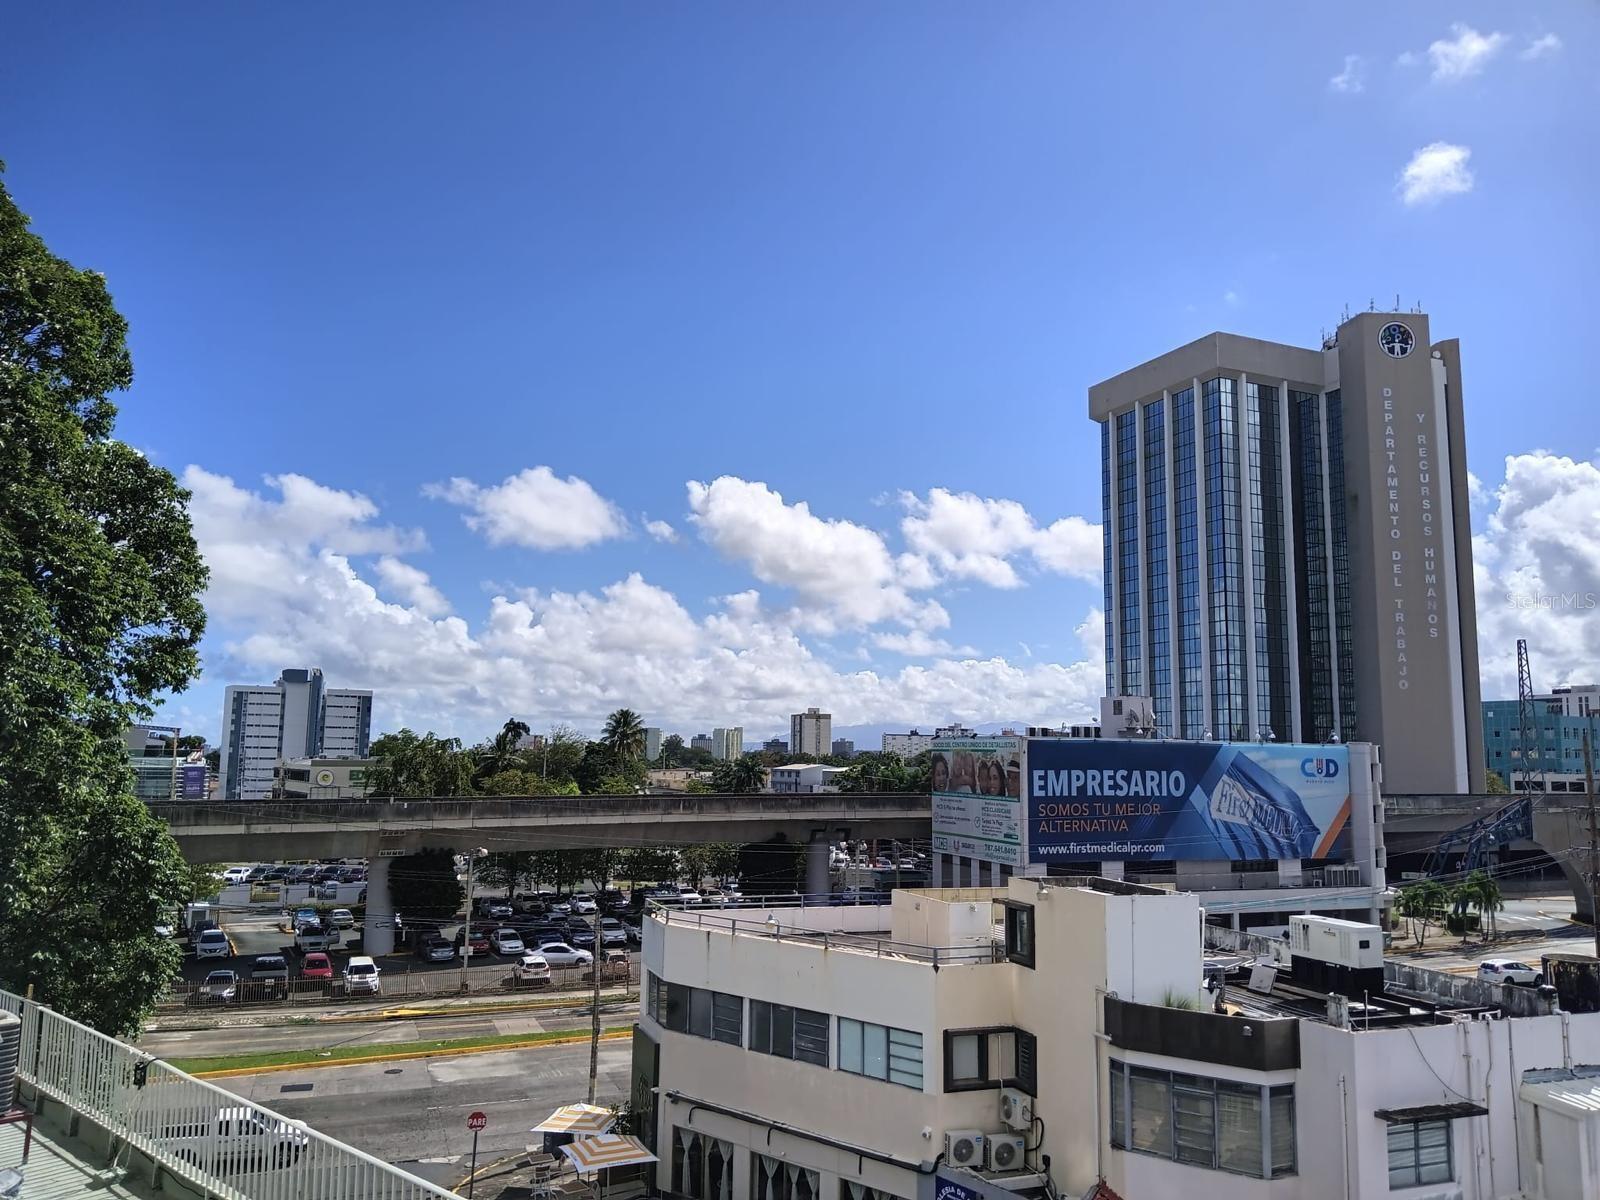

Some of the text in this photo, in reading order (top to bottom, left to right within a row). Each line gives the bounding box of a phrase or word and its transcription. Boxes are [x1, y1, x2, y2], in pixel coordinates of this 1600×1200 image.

[1416, 413, 1438, 638] Y RECURSOS HUMANOS
[1383, 387, 1408, 690] DEPARTAMENTO DEL TRABAJO
[1032, 769, 1186, 798] EMPRESARIO
[1038, 803, 1161, 817] SOMOS TU MEJOR
[1038, 819, 1129, 833] ALTERNATIVA
[1038, 841, 1165, 855] www.firstmedicalpr.com
[468, 1117, 486, 1126] PARE
